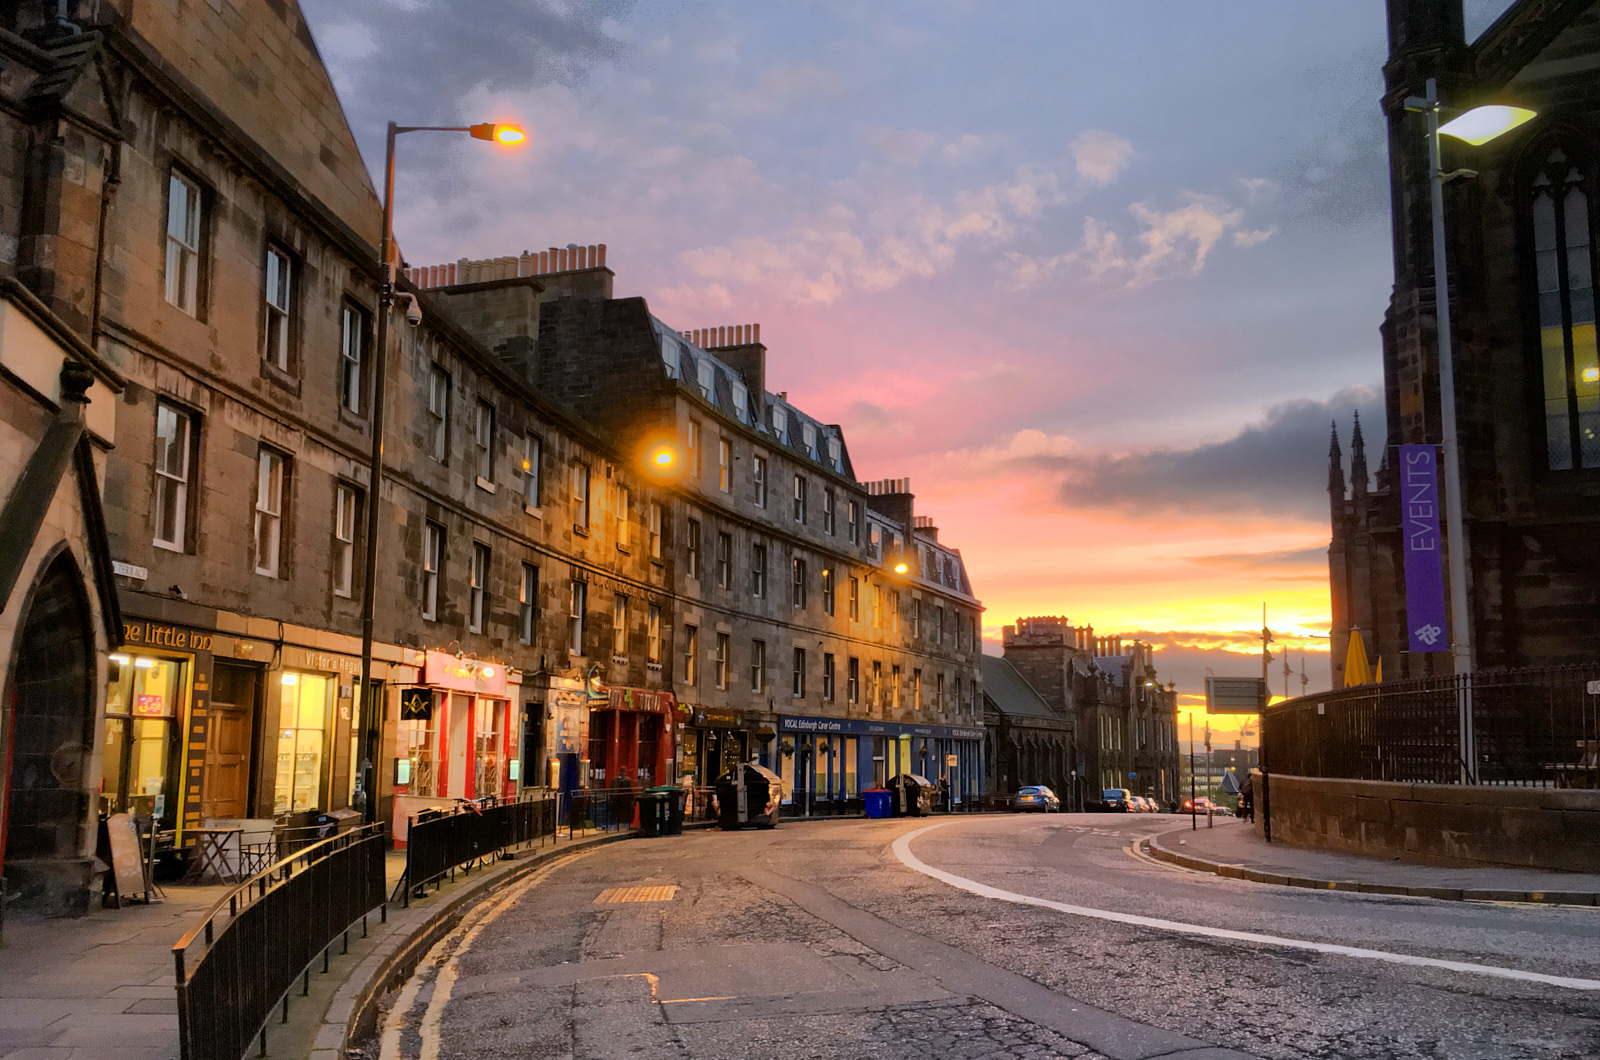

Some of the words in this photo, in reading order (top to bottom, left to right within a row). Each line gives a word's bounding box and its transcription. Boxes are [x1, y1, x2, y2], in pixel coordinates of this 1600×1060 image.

[1407, 451, 1434, 551] EVENTS
[123, 624, 141, 642] he
[306, 652, 337, 670] Victoria
[784, 719, 798, 729] VOCAL
[798, 720, 818, 731] Edinburgh
[829, 722, 841, 731] Centre
